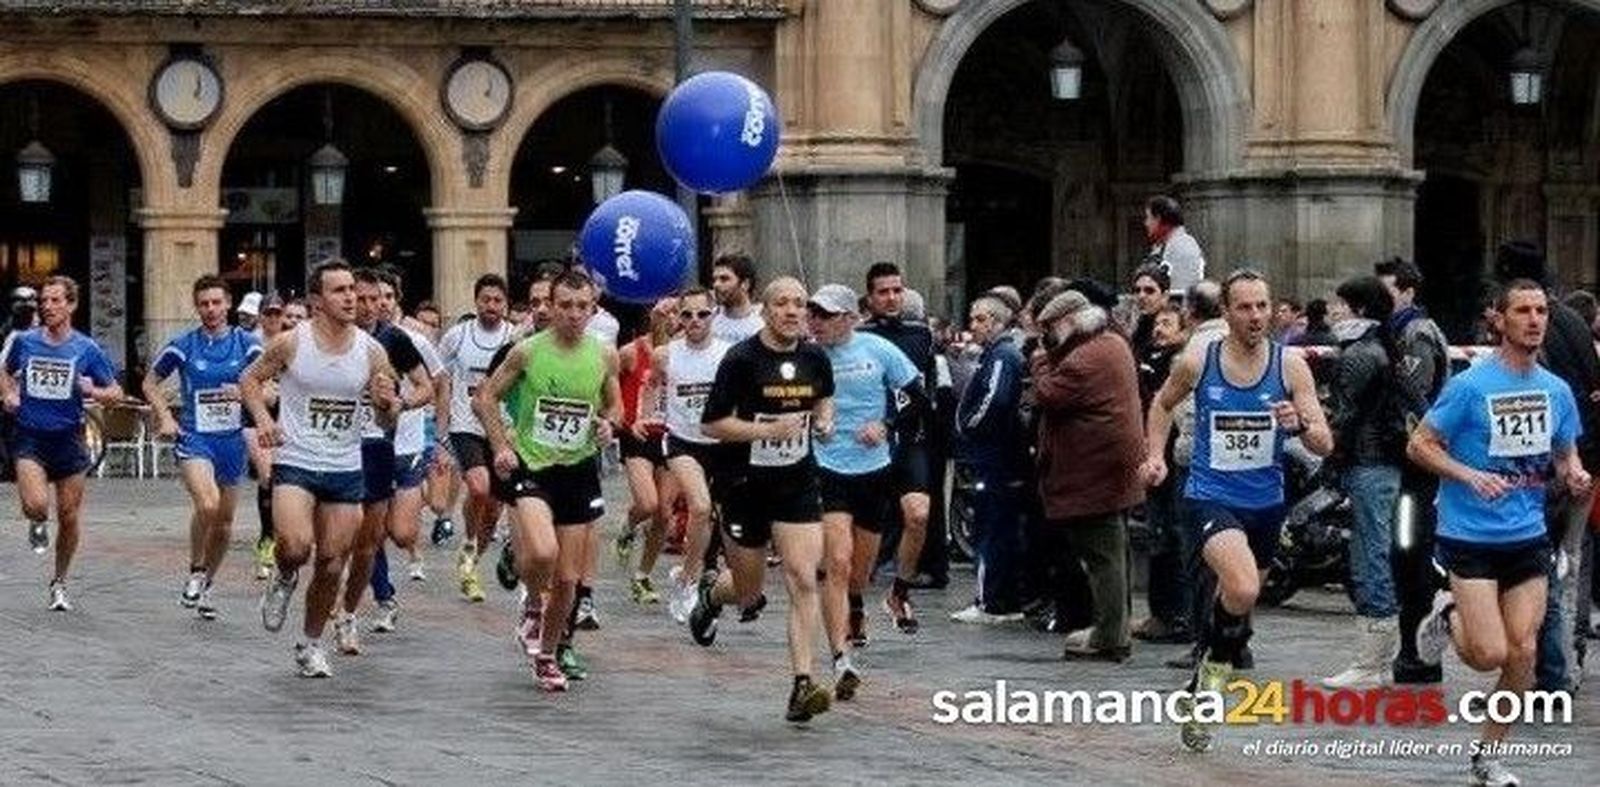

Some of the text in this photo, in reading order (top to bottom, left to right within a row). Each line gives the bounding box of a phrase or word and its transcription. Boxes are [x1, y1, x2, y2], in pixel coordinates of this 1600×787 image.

[31, 370, 70, 386] 1237
[544, 414, 581, 435] 573
[1497, 412, 1546, 436] 1211
[1225, 434, 1259, 450] 384
